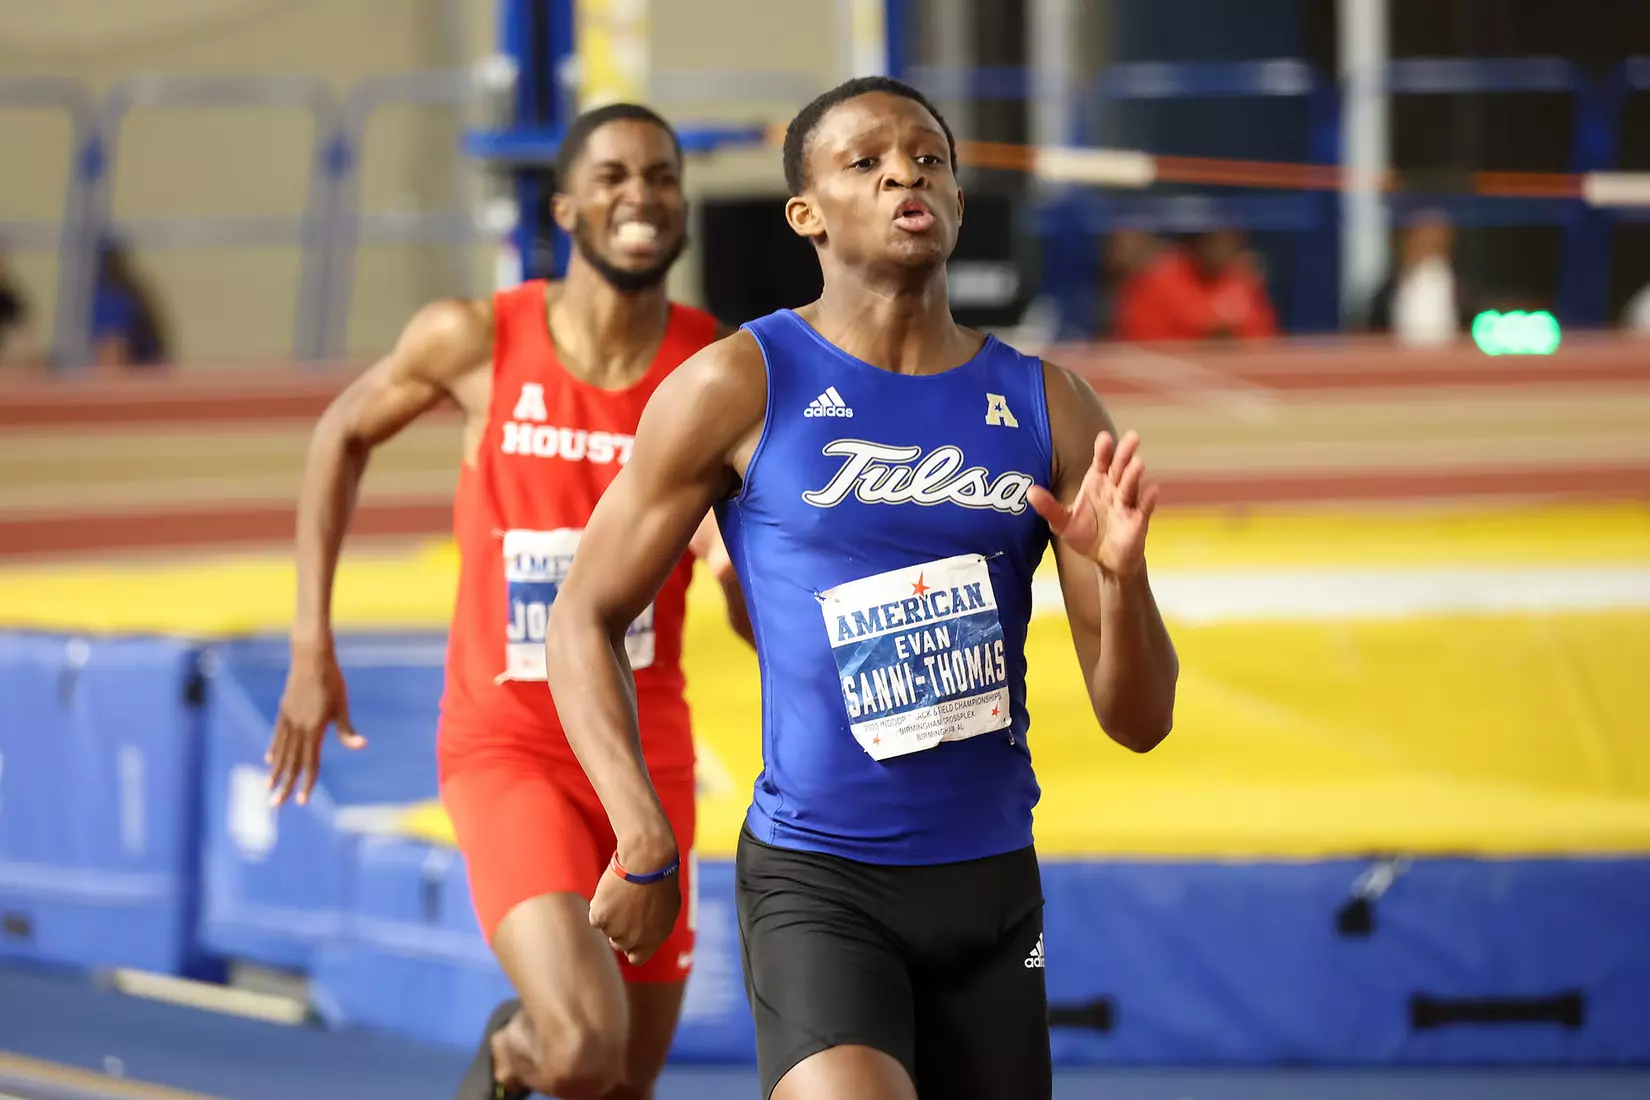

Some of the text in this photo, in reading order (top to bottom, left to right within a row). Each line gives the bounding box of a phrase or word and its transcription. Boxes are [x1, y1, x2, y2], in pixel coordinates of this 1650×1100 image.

[513, 382, 548, 421] A
[803, 406, 853, 418] adidas
[985, 392, 1019, 428] A
[801, 438, 1034, 516] Tulsa
[836, 582, 987, 642] AMERICAN
[894, 625, 951, 660] EVAN
[843, 640, 1006, 718] SANNI-THOMAS
[954, 691, 1002, 711] CHAMPIONSHIPS
[898, 710, 976, 736] BIRMINGHAM CROSSPLEX
[916, 725, 956, 741] BIRMINGHAM
